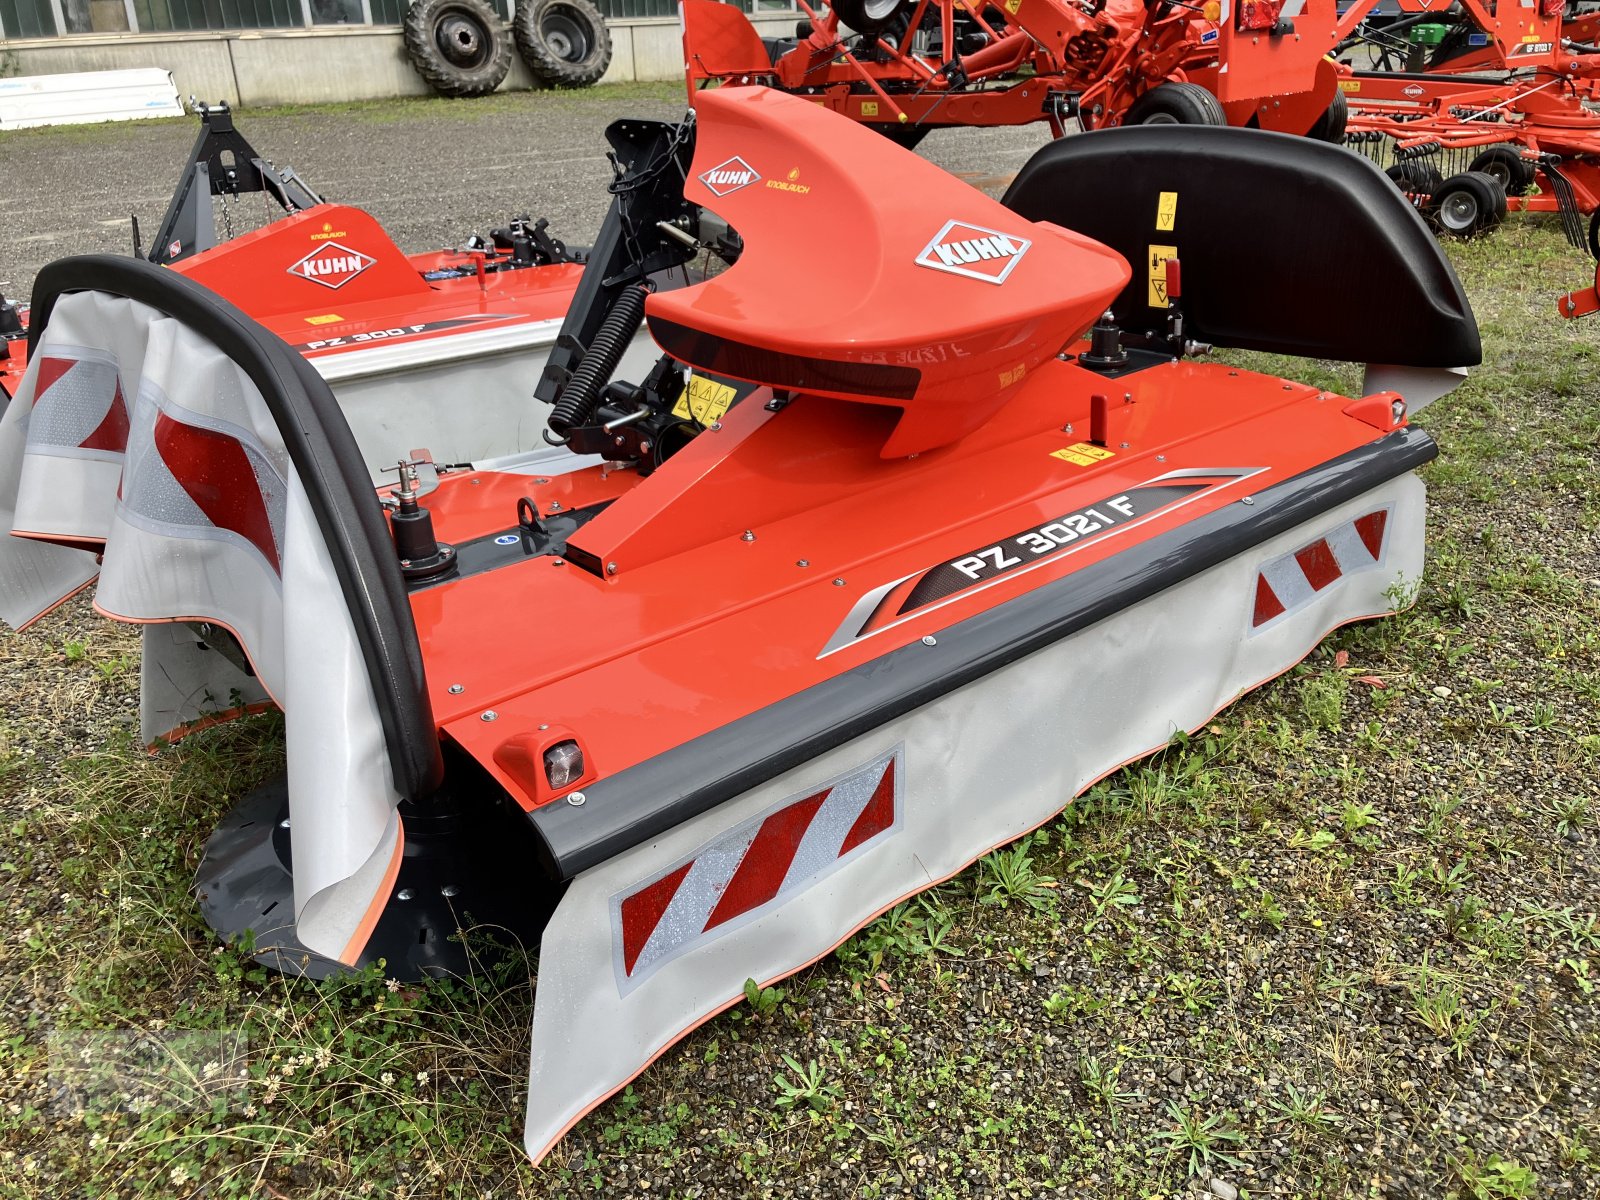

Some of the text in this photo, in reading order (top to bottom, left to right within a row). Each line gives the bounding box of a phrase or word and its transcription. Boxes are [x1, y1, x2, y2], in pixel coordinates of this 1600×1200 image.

[707, 171, 751, 185] KUHN
[932, 234, 1019, 266] KUHN
[302, 255, 362, 277] KUHN
[307, 337, 346, 349] PZ
[352, 328, 405, 341] 300
[410, 324, 425, 333] F
[951, 495, 1135, 579] PZ 3021 F
